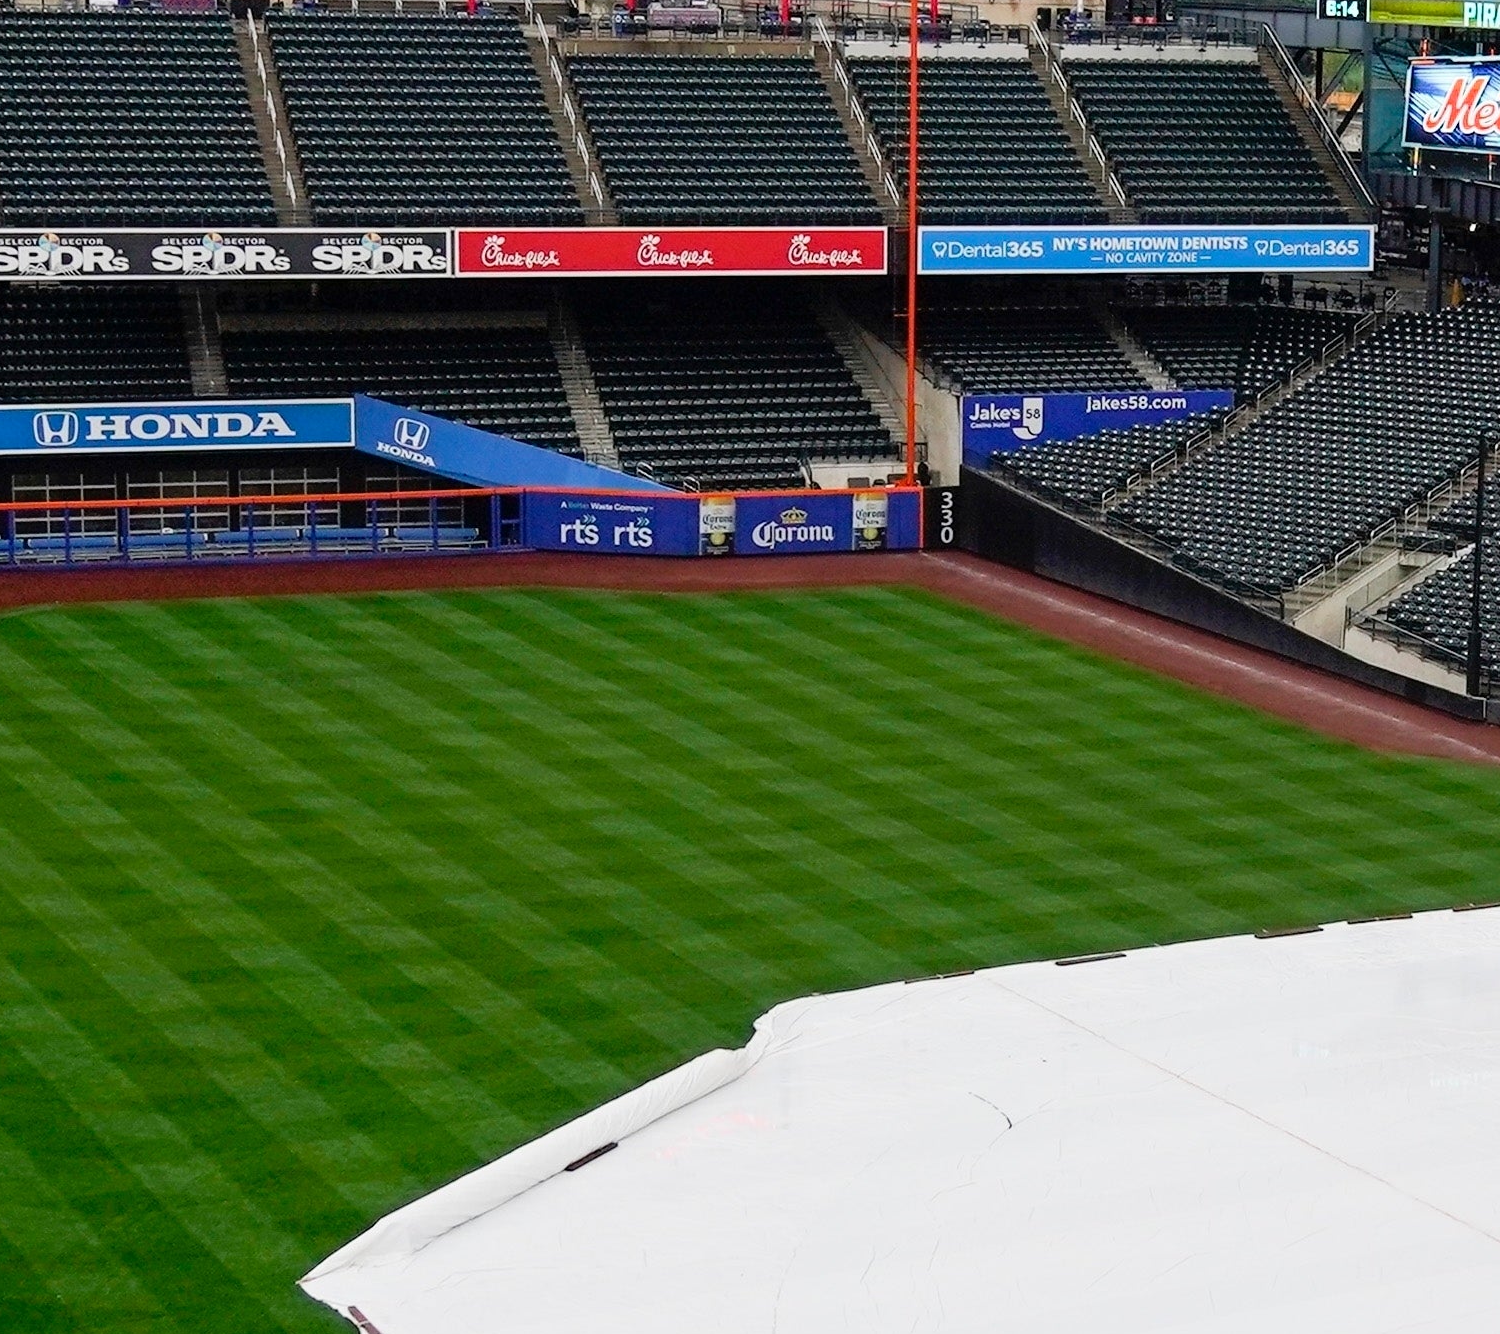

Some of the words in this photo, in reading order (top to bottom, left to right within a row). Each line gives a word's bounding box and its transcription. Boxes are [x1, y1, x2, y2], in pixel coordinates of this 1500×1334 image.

[60, 238, 103, 247] SECTOR
[162, 238, 202, 246] SELECT
[224, 238, 265, 247] SECTOR
[322, 237, 362, 246] SELECT
[382, 237, 423, 246] SECTOR
[948, 241, 1044, 258] Dental365
[1052, 237, 1088, 251] NY'S
[1090, 236, 1179, 251] HOMETOWN
[1181, 236, 1249, 250] DENTISTS
[1269, 240, 1359, 256] Dental365
[1105, 253, 1123, 263] NO
[1126, 252, 1167, 263] CAVITY
[1167, 252, 1198, 263] ZONE
[969, 403, 1021, 421] Jake's
[1025, 408, 1041, 420] 58
[1086, 395, 1187, 413] jakes58.com
[85, 412, 296, 441] HONDA
[376, 441, 436, 467] HONDA
[591, 503, 613, 511] Waste
[614, 504, 648, 515] Company
[560, 517, 599, 546] rts
[614, 519, 653, 548] rts
[752, 520, 835, 549] Corona
